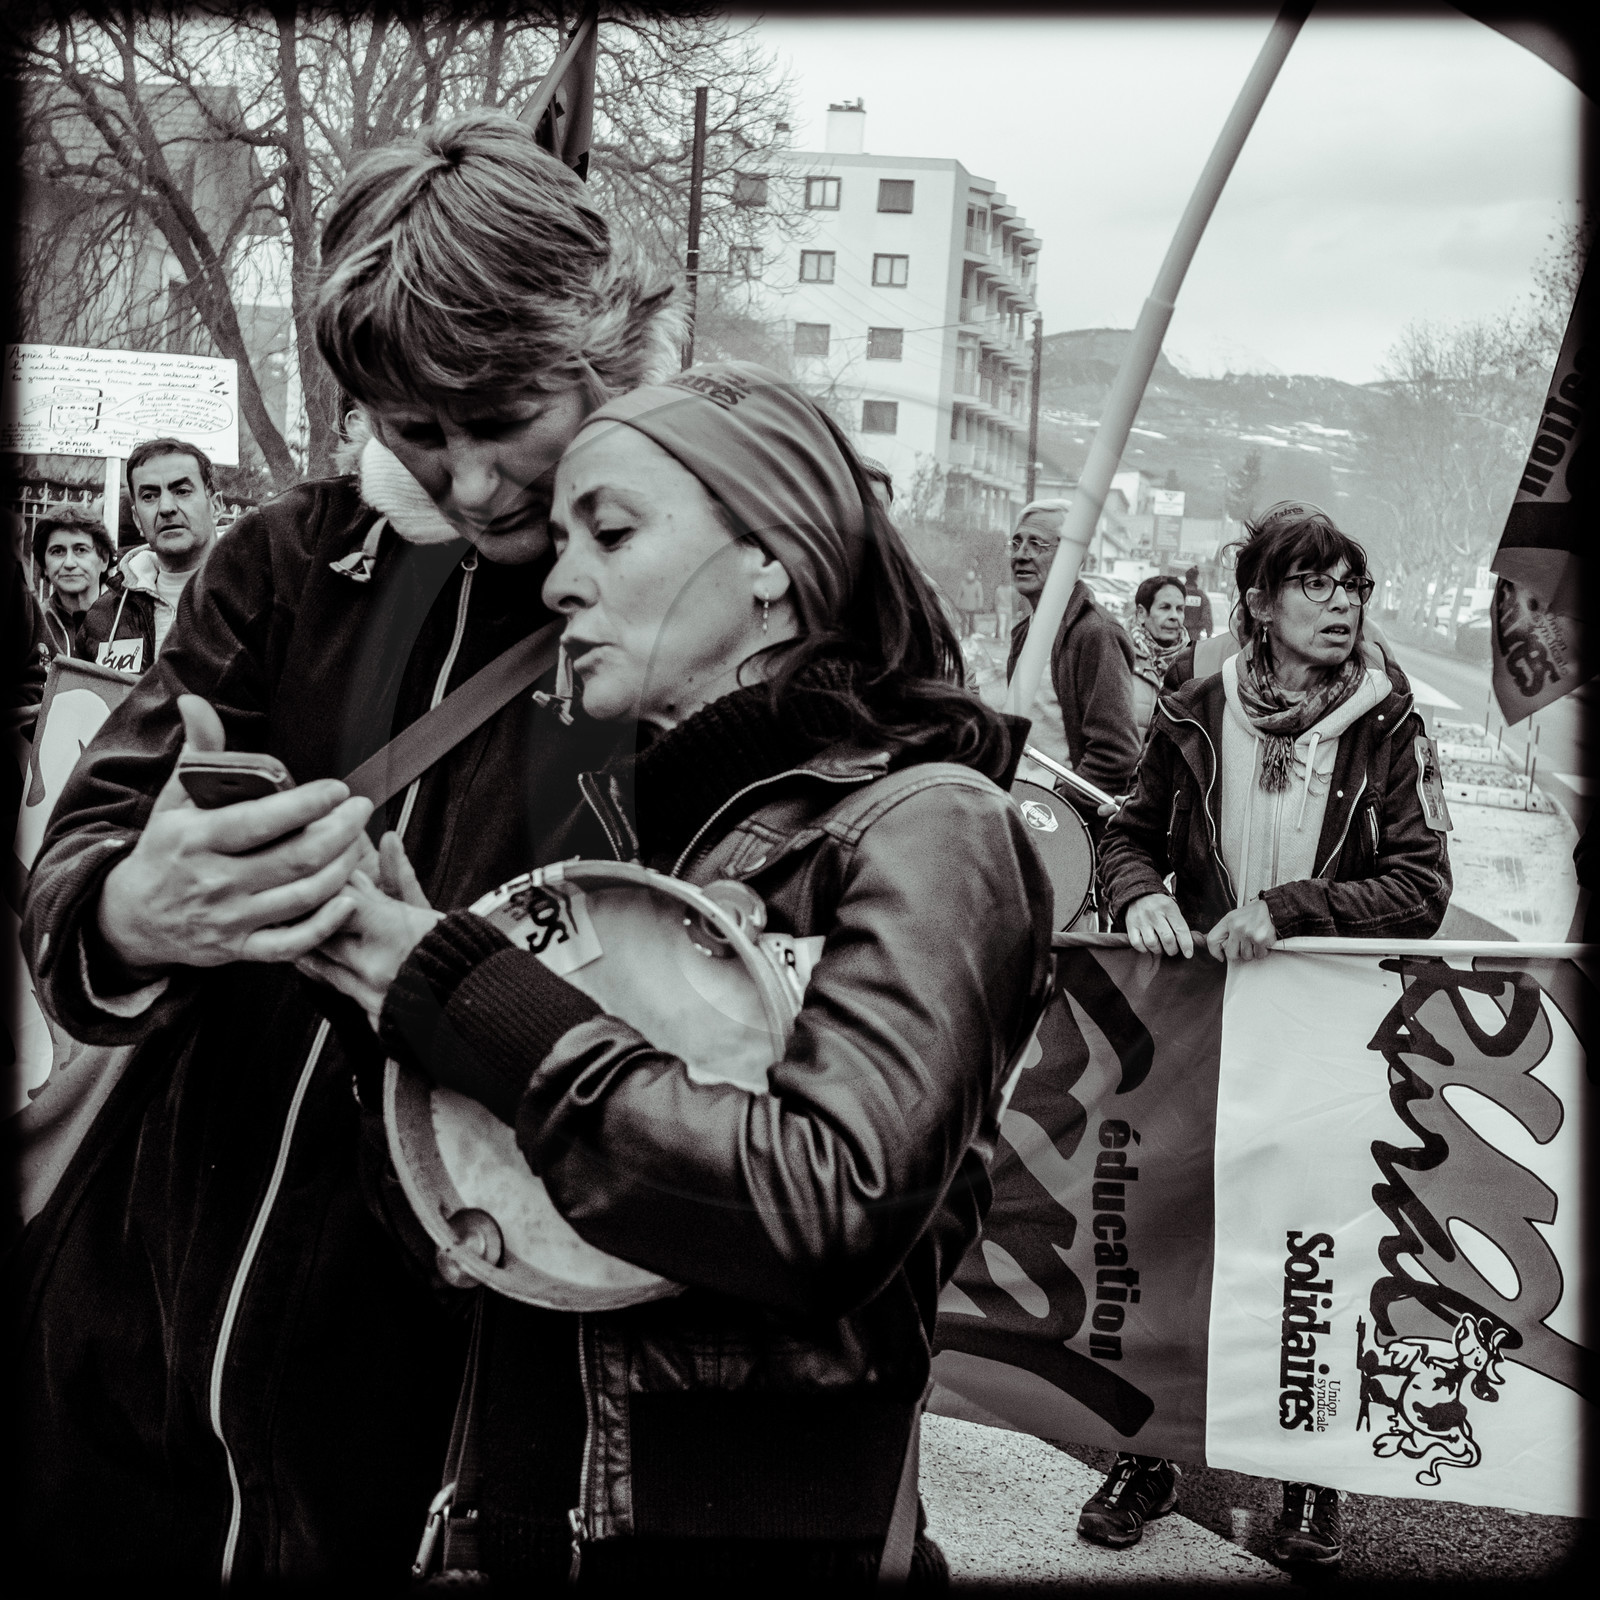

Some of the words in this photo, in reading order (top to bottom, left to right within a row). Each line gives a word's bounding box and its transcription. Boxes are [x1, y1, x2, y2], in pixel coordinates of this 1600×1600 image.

[1090, 1118, 1144, 1362] éducation
[1368, 957, 1542, 1350] Rural
[1279, 1230, 1336, 1433] Solidaires
[1314, 1378, 1330, 1433] syndicale
[1328, 1379, 1341, 1418] Union
